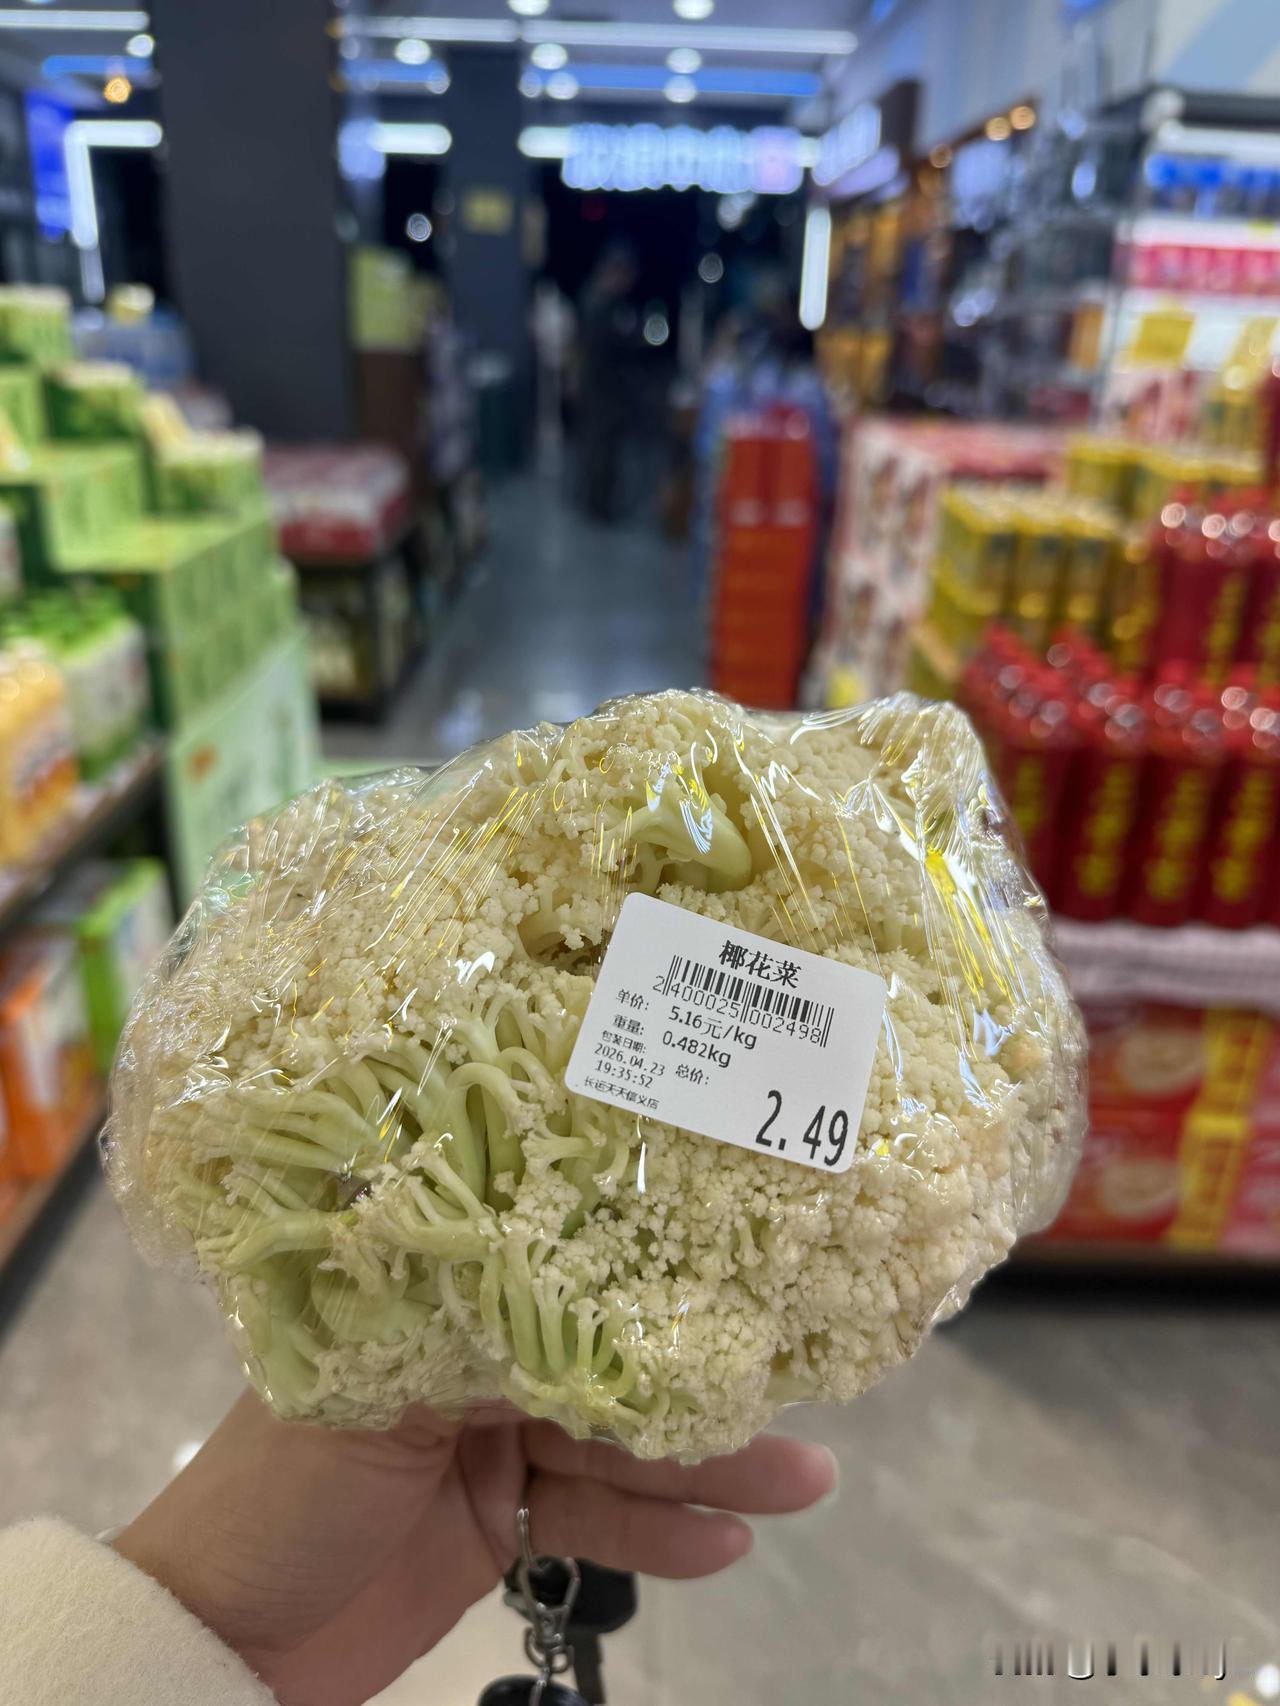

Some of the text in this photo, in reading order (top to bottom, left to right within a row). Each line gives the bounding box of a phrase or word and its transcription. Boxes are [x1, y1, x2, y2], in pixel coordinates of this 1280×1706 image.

[719, 939, 802, 988] 椰花菜
[616, 988, 757, 1050] 单价: 5.16元/kg
[594, 1043, 666, 1076] 2026.04.23
[601, 1030, 647, 1054] 包装日期:
[612, 1014, 732, 1068] 重量: 0.482kg
[595, 1060, 654, 1088] 19:35:52
[675, 1064, 711, 1085] 总价:
[755, 1090, 849, 1167] 2.49
